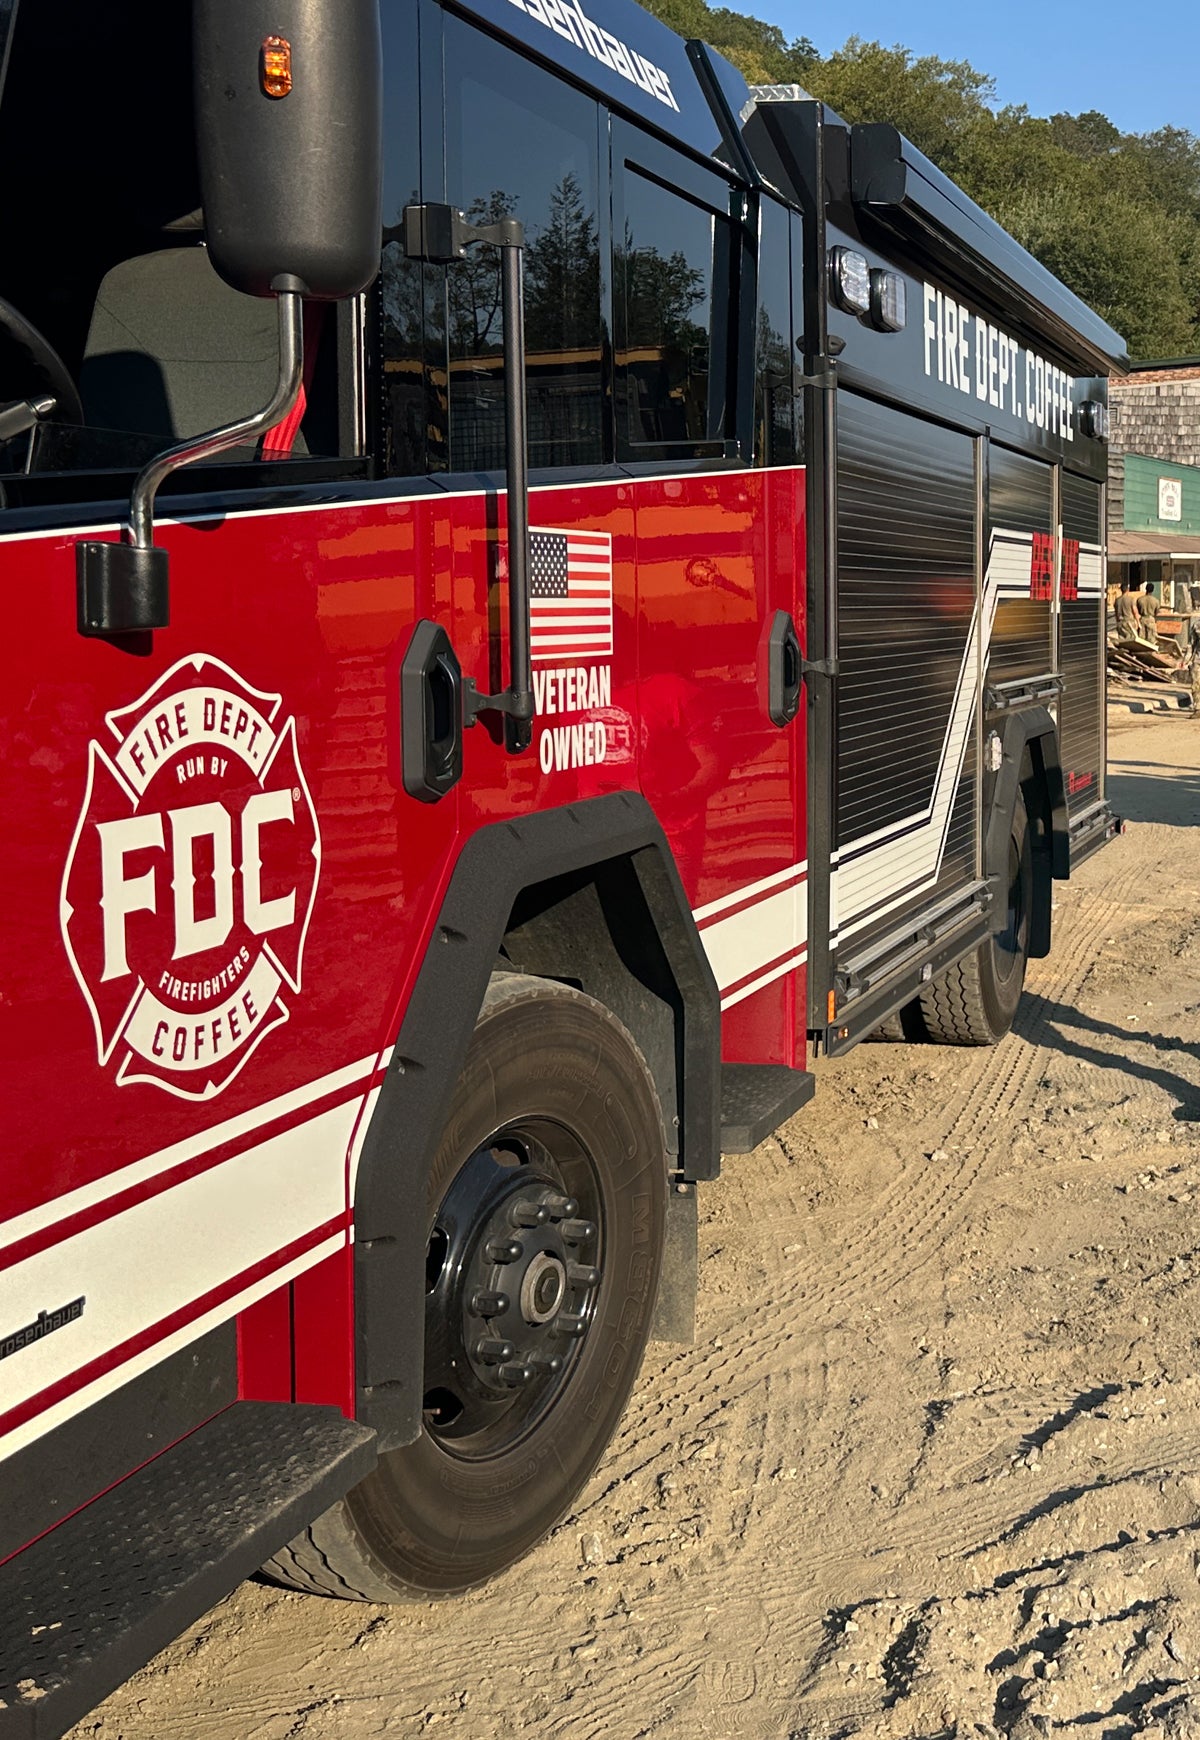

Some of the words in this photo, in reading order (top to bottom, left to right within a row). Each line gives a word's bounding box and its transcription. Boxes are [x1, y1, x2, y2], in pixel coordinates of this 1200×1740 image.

[924, 281, 970, 394] FIRE
[975, 316, 1022, 418] DEPT.
[1026, 349, 1074, 442] COFFEE
[532, 665, 611, 716] VETERAN
[129, 702, 189, 777] FIRE
[203, 697, 262, 760] DEPT.
[540, 721, 607, 774] OWNED
[176, 756, 204, 784] RUN
[211, 756, 228, 778] BY
[158, 945, 250, 1002] FIREFIGHTERS
[152, 989, 258, 1062] COFFEE
